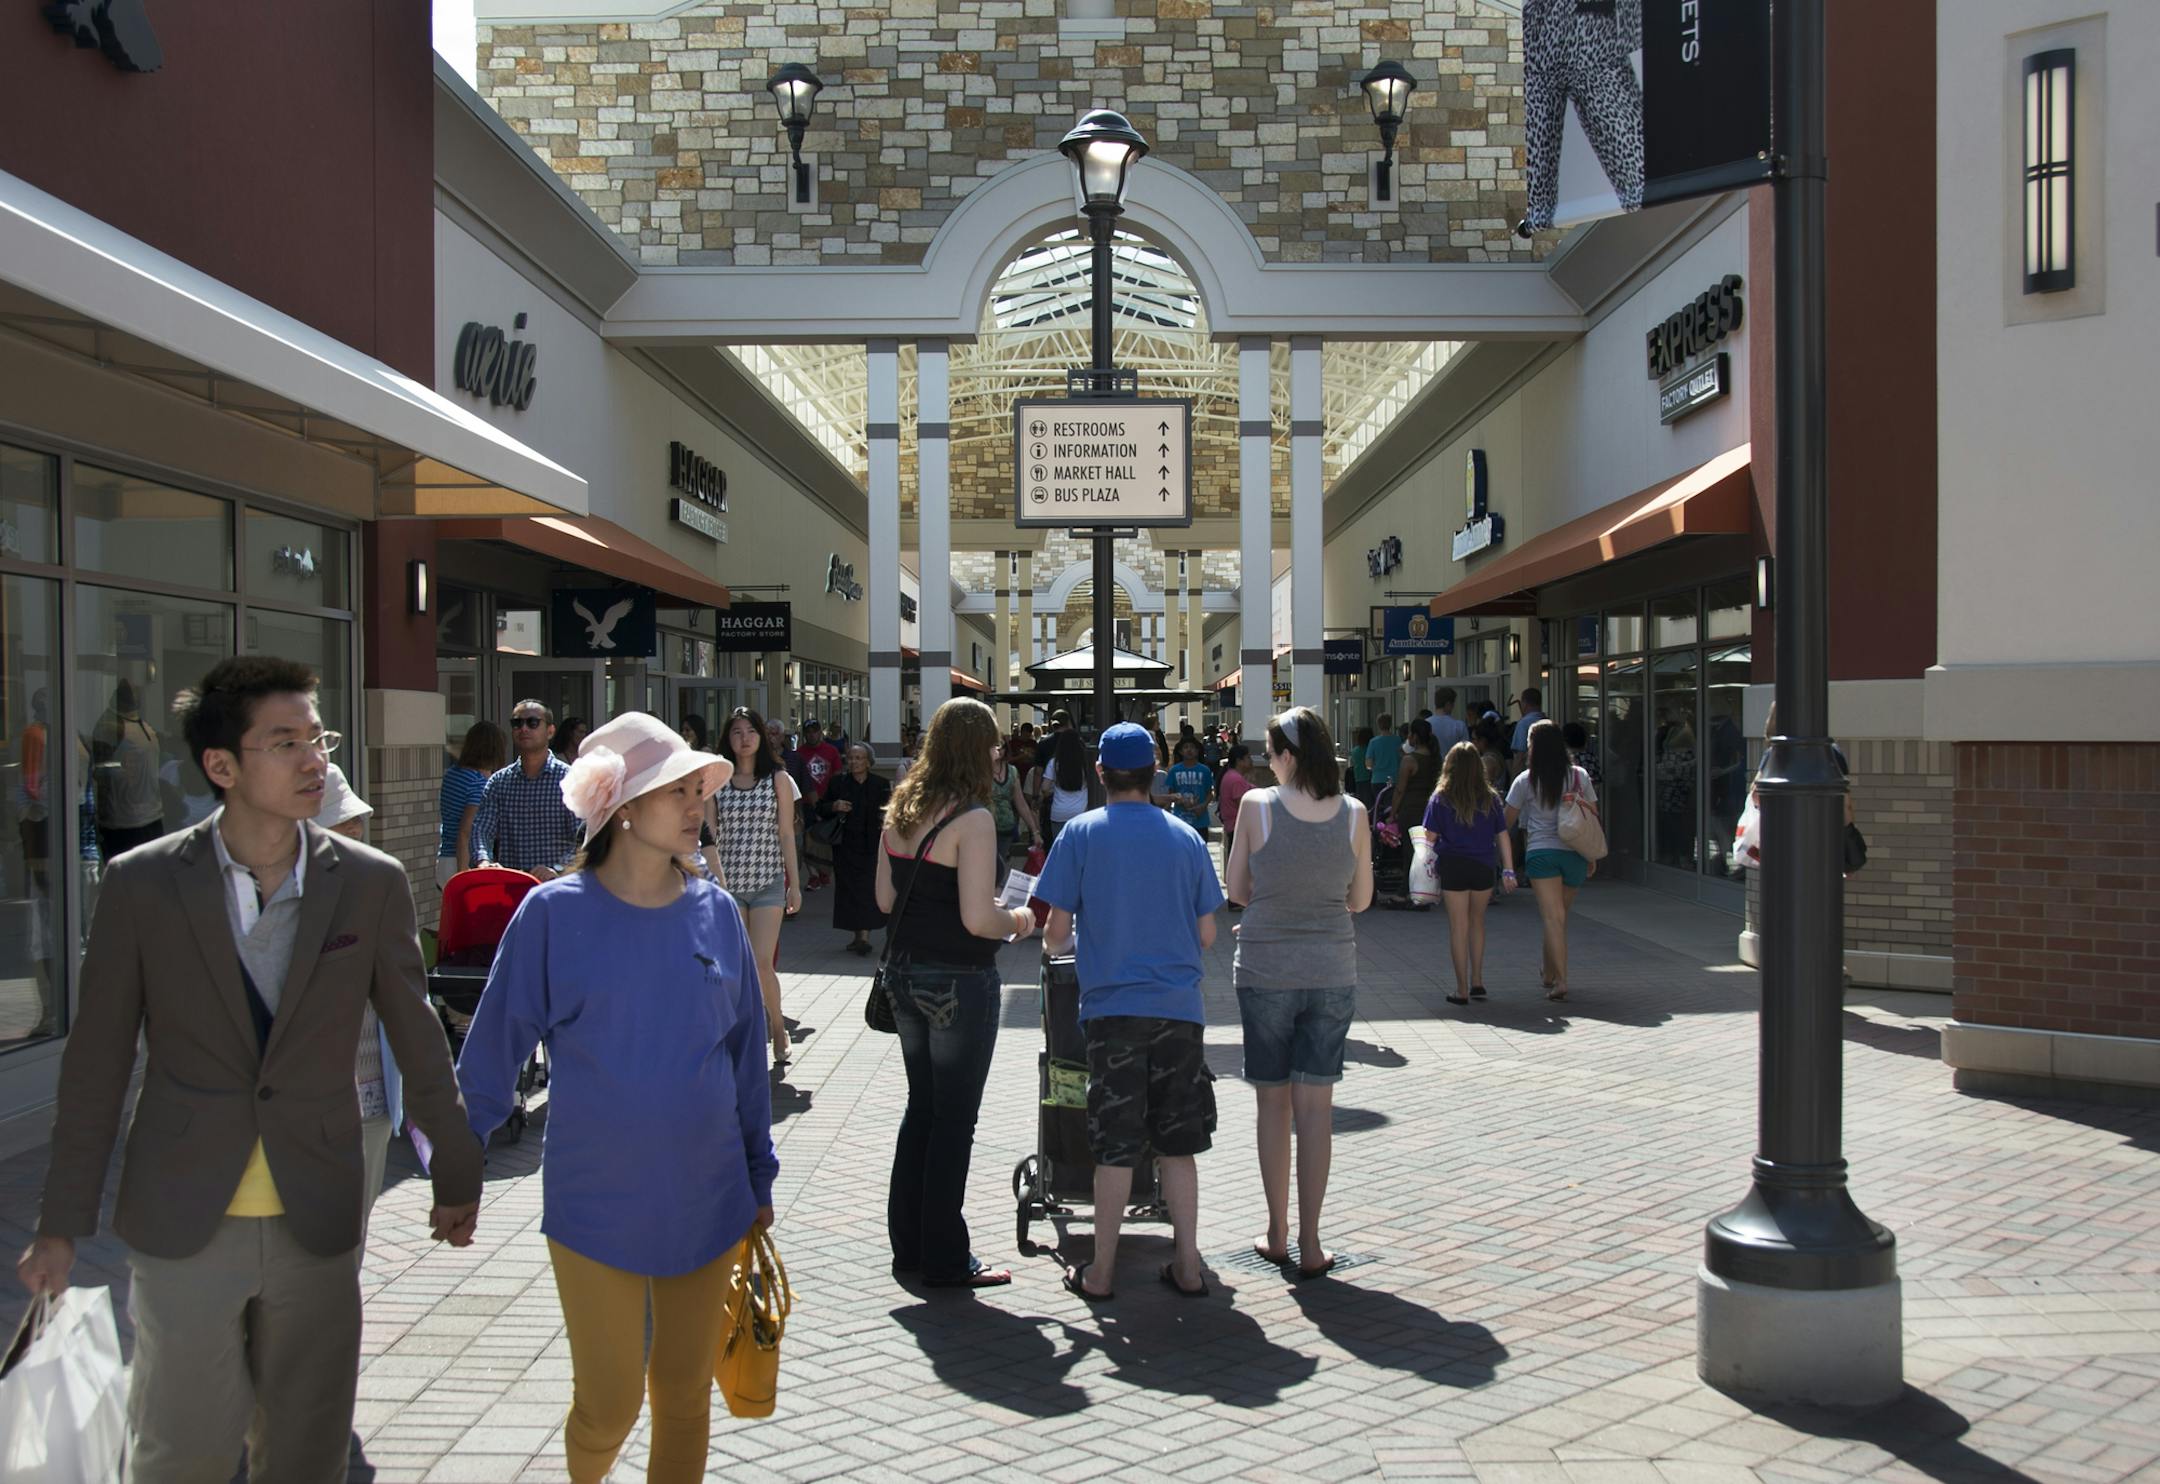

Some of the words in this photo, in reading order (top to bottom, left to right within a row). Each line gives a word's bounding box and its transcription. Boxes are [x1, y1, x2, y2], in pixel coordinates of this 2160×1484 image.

[1681, 0, 1700, 63] ETS
[1646, 274, 1744, 380] EXPRESS
[453, 312, 538, 411] aerie
[1660, 384, 1688, 412] FACTORY
[1688, 369, 1716, 397] OUTLET
[1054, 422, 1126, 437] RESTROOMS
[1054, 443, 1137, 458] INFORMATION
[671, 441, 729, 512] HAGGAR
[1054, 466, 1101, 480] MARKET
[1105, 466, 1136, 480] HALL
[1055, 488, 1078, 502] BUS
[1082, 488, 1120, 502] PLAZA
[720, 616, 785, 629] HAGGAR
[720, 630, 756, 638] FACTORY
[759, 630, 785, 638] STORE
[1175, 770, 1204, 786] FAIL!
